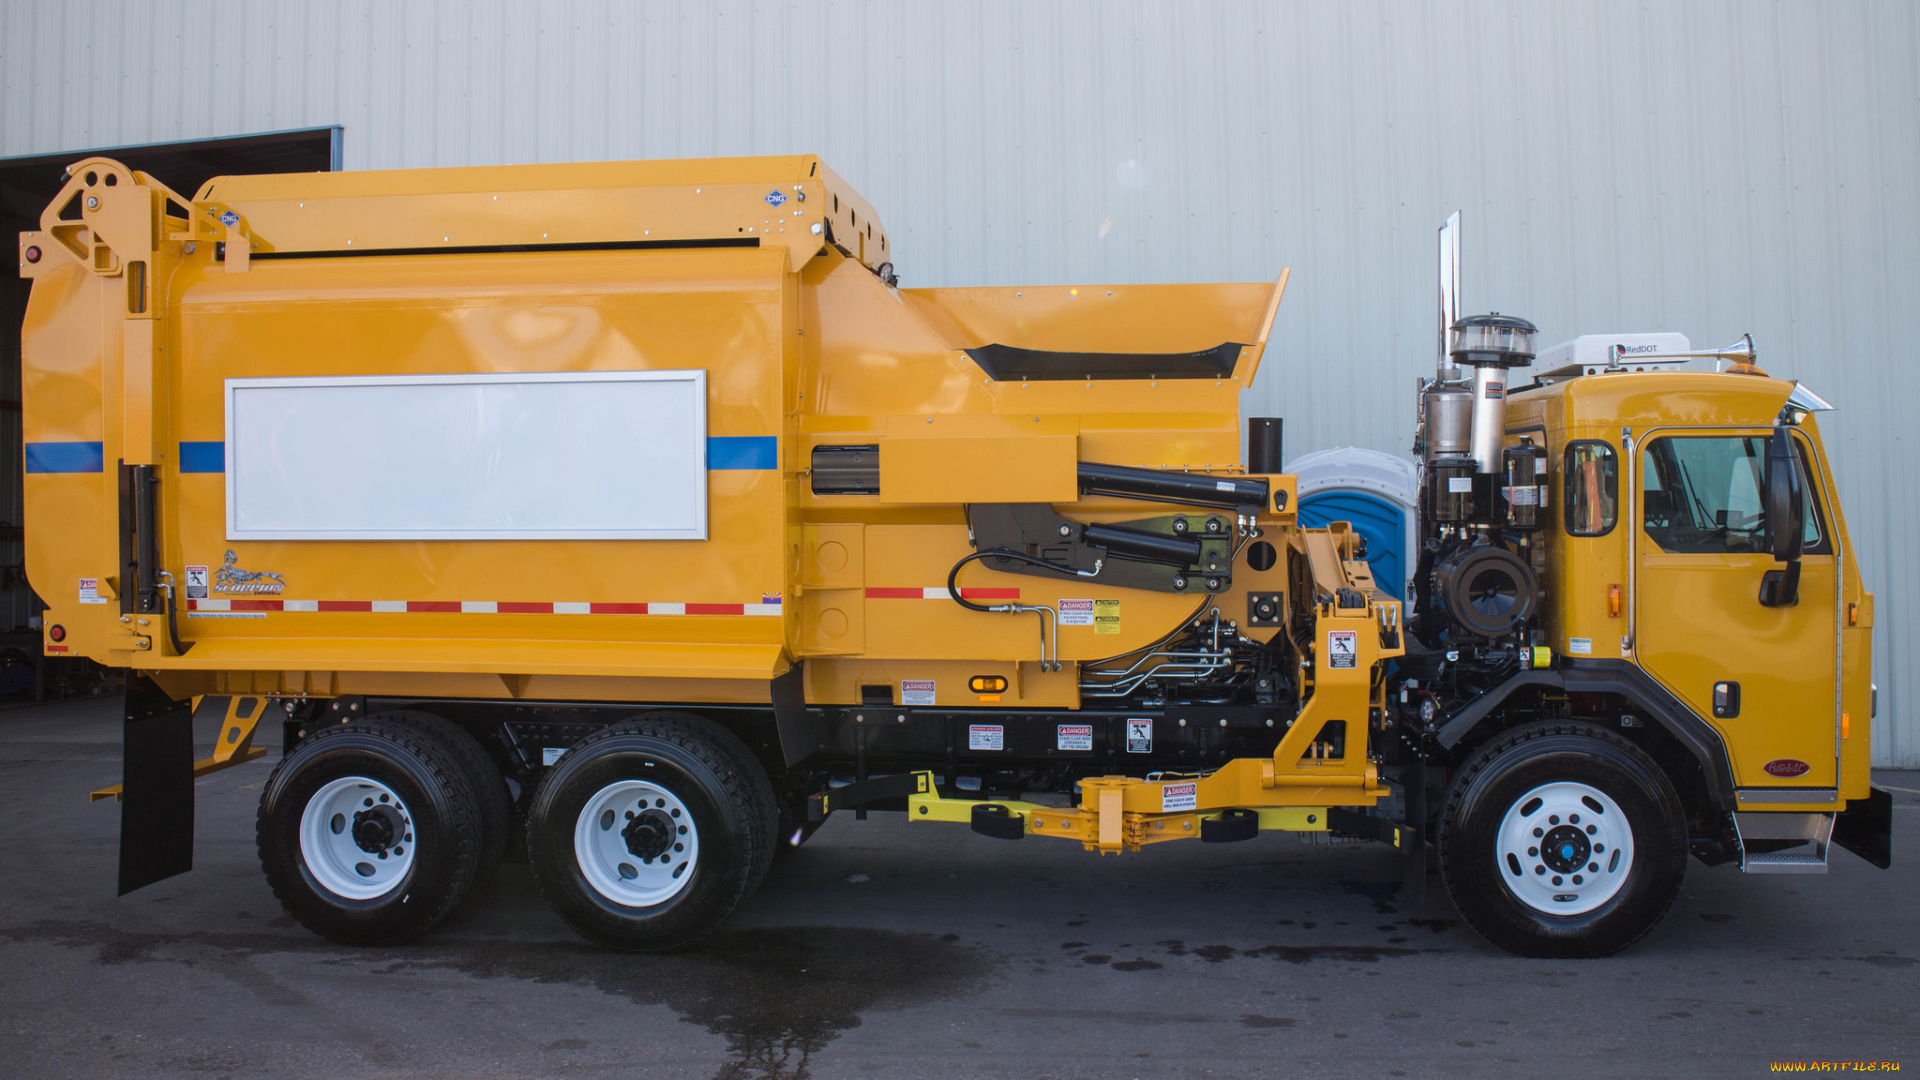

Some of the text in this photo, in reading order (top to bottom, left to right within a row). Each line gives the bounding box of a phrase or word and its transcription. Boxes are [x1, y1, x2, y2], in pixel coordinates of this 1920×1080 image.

[1626, 344, 1658, 354] RedDOT
[213, 583, 286, 593] SCORPION
[1769, 761, 1806, 773] Peterbilt
